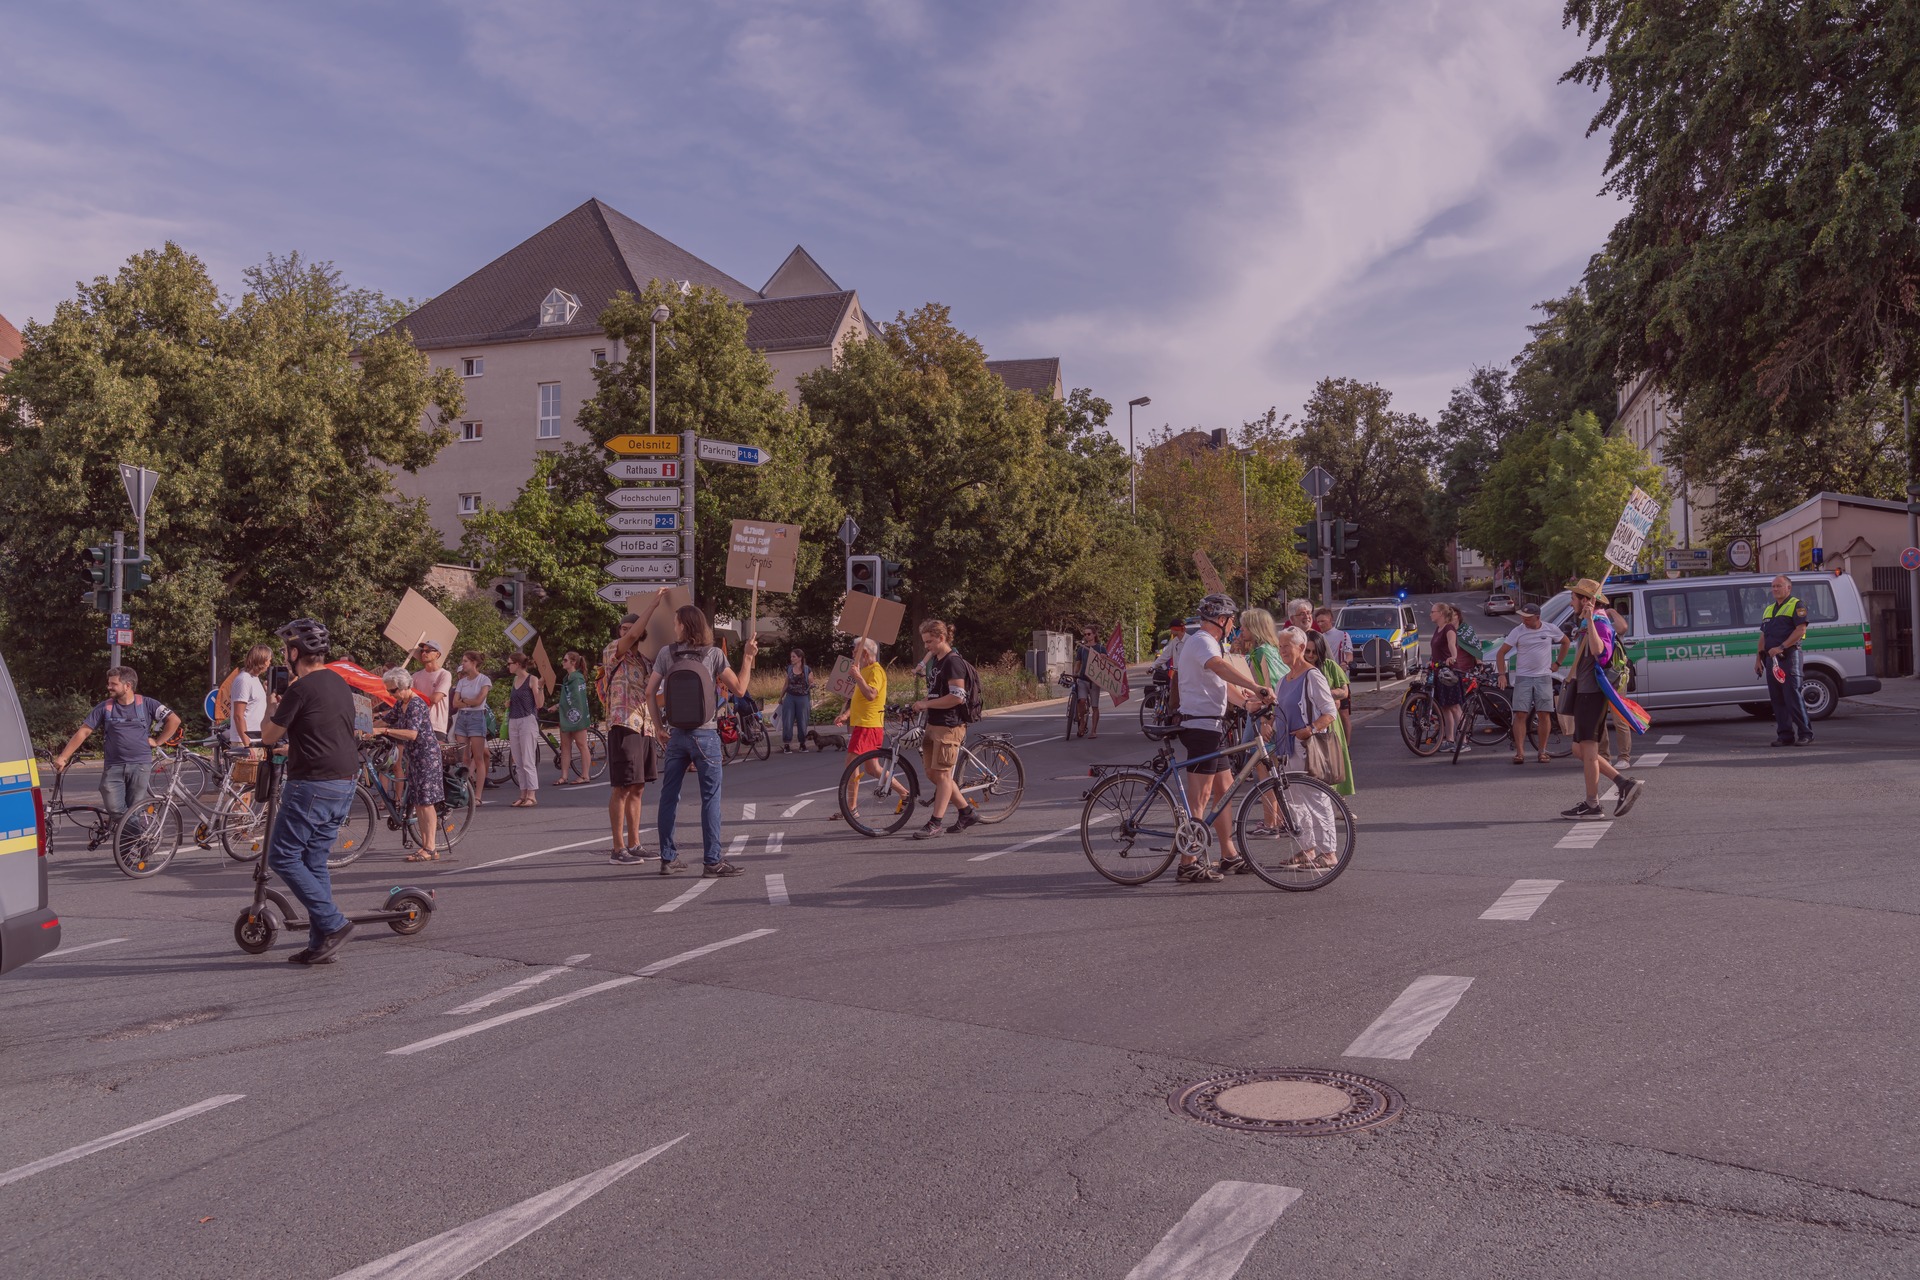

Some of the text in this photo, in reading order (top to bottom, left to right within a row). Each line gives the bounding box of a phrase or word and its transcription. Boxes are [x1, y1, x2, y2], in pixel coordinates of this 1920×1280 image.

[628, 439, 672, 450] Oelsnitz
[702, 444, 736, 458] Parkring
[626, 464, 658, 474] Rathaus
[619, 518, 652, 526] Parkring
[620, 539, 658, 550] HofBad
[620, 564, 659, 572] Grüne Au
[1666, 644, 1726, 660] POLIZEI
[1092, 653, 1122, 682] AUTO
[1088, 664, 1119, 694] BAHN
